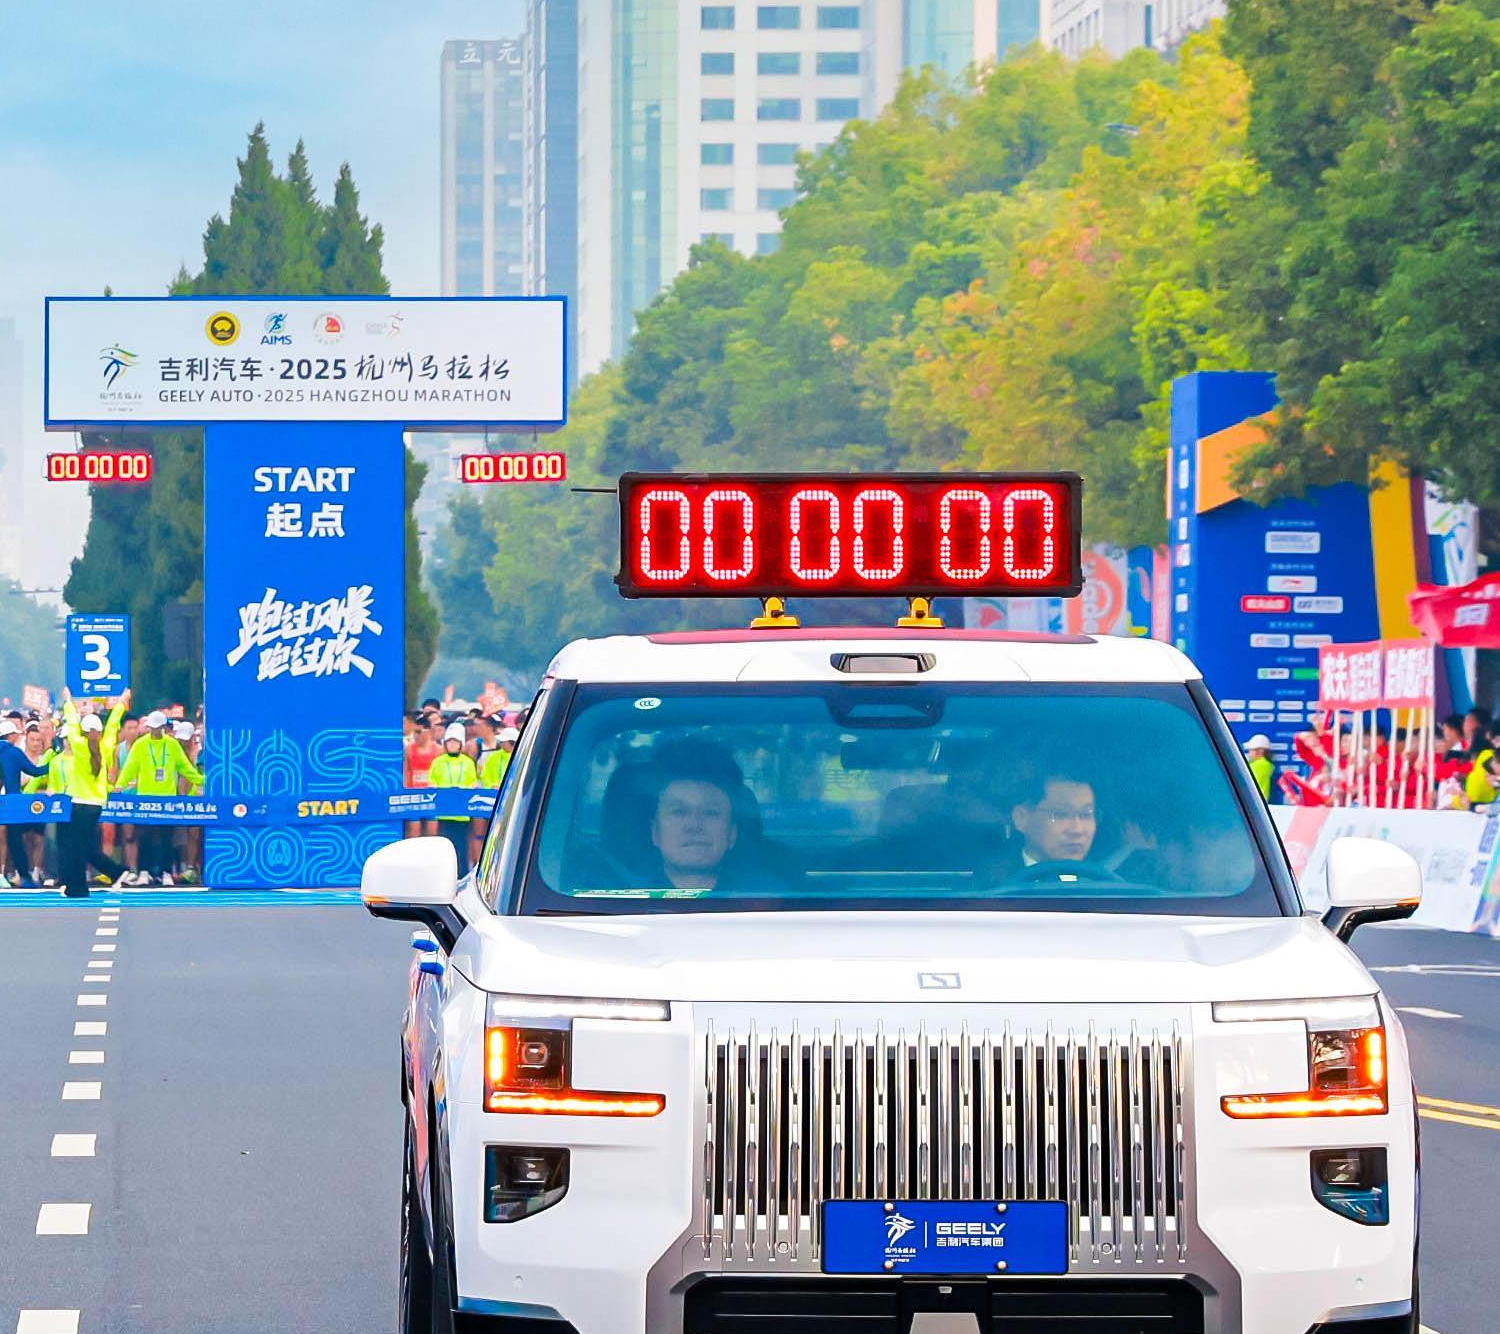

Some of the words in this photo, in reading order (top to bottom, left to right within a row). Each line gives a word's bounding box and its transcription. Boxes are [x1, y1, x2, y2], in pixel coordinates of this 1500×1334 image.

[260, 335, 292, 346] AIMS
[159, 389, 205, 404] GEELY
[310, 389, 409, 403] HANGZHOU
[414, 389, 511, 402] MARATHON
[253, 467, 355, 492] START
[265, 503, 345, 538] 起点
[640, 489, 753, 580] 00
[789, 489, 904, 580] 00
[939, 489, 1055, 580] 00
[80, 634, 111, 680] 3
[388, 793, 437, 806] GEELY
[297, 799, 360, 818] START
[936, 1222, 1006, 1235] GEELY
[936, 1237, 1004, 1247] 吉利汽车集团
